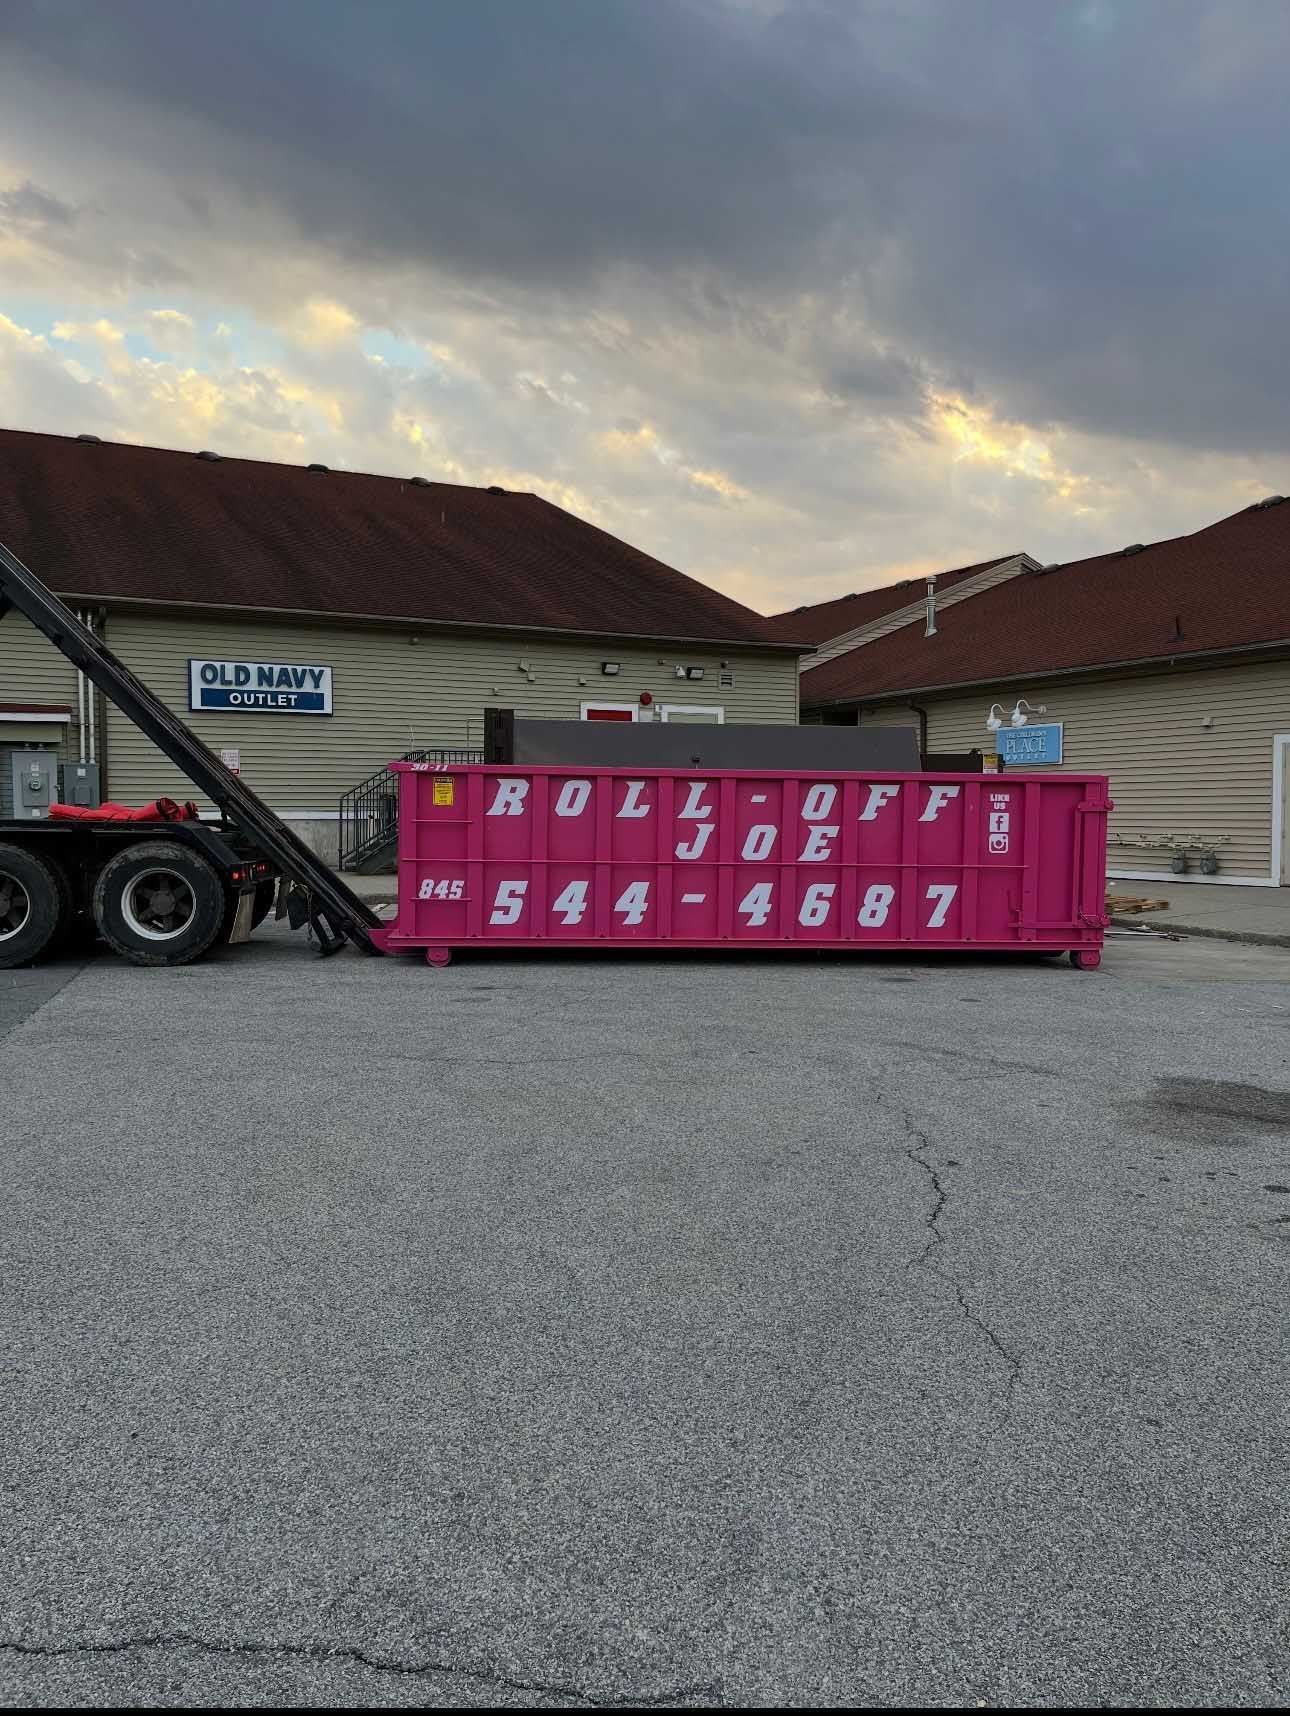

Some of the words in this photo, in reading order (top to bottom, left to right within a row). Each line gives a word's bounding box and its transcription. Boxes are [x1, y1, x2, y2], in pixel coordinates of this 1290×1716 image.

[200, 663, 250, 687] OLD
[257, 666, 324, 689] NAVY
[229, 692, 298, 706] OUTLET
[1006, 737, 1047, 753] PLACE
[993, 802, 1006, 810] US
[675, 823, 840, 862] JOE
[418, 879, 465, 899] 845
